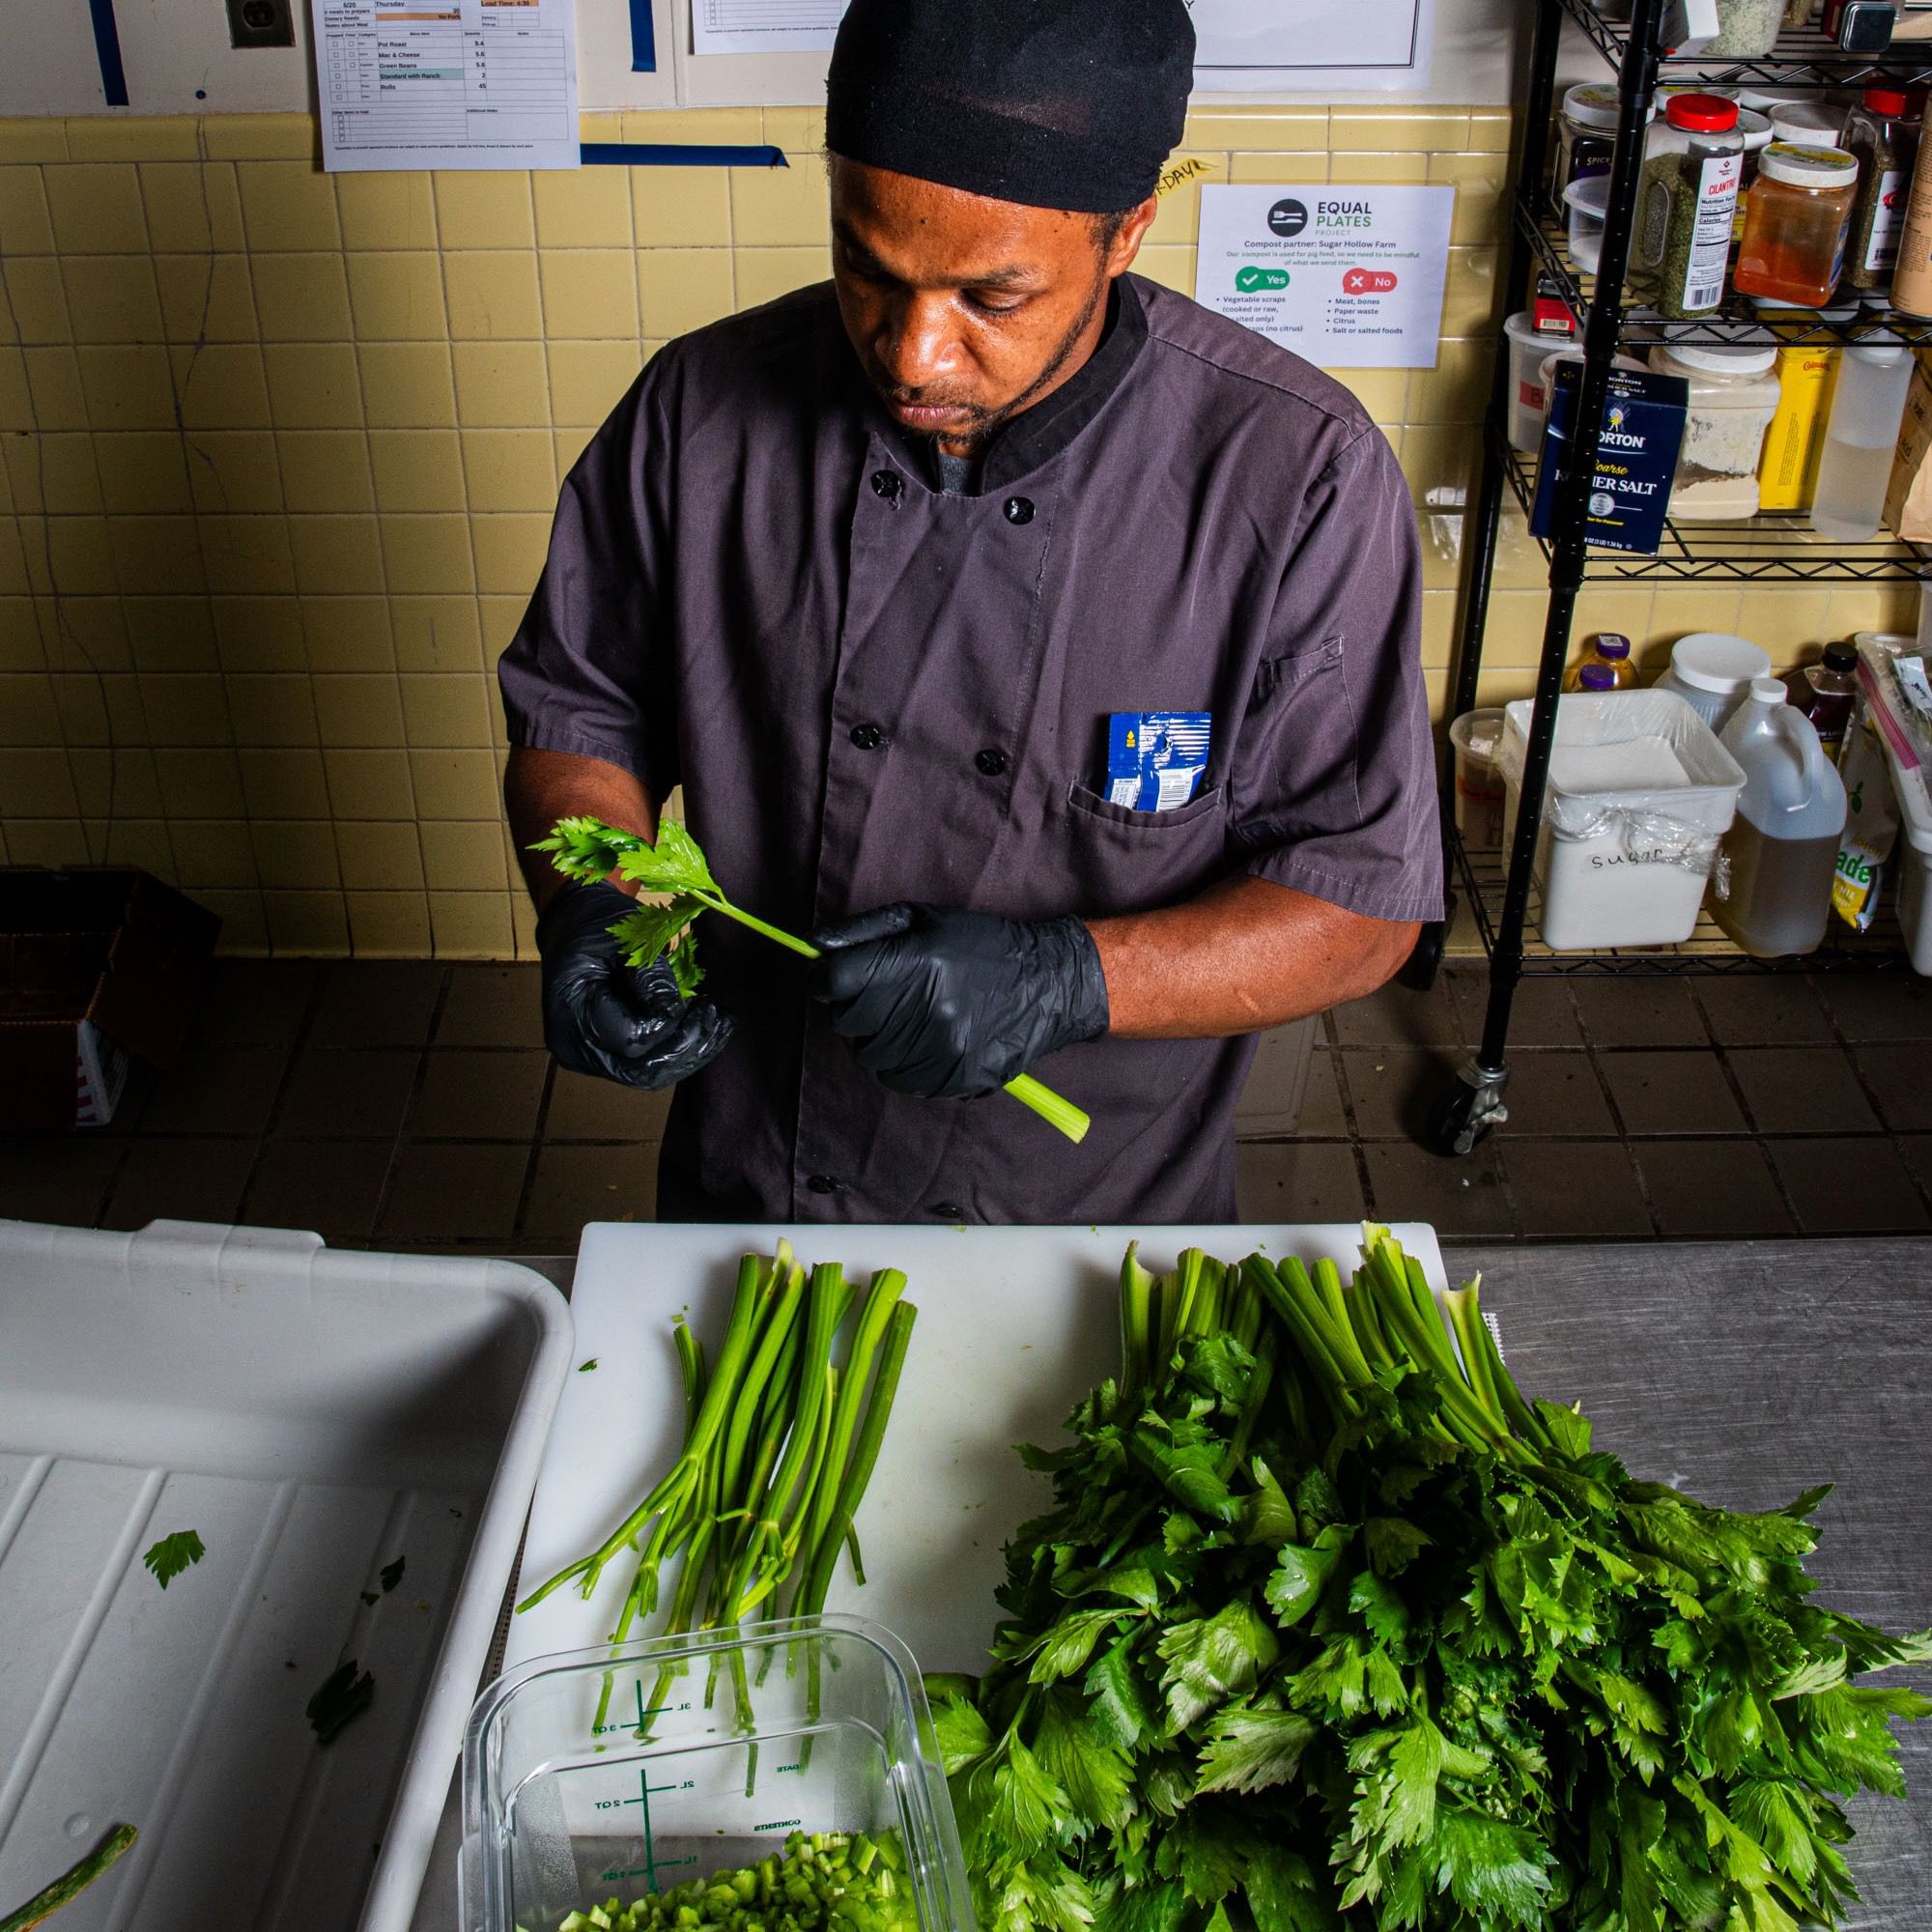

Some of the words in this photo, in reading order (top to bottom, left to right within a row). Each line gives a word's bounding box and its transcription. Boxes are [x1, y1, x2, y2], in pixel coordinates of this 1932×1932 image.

[1709, 178, 1736, 196] CILANTR
[1318, 201, 1372, 214] EQUAL
[1317, 215, 1372, 227] PLATES
[1244, 240, 1281, 248] Compost
[1319, 240, 1342, 248] Sugar
[1267, 275, 1286, 284] Yes
[1375, 278, 1391, 286] No
[1255, 316, 1274, 324] only)
[1599, 431, 1644, 449] ORTON
[1618, 480, 1657, 495] SALT
